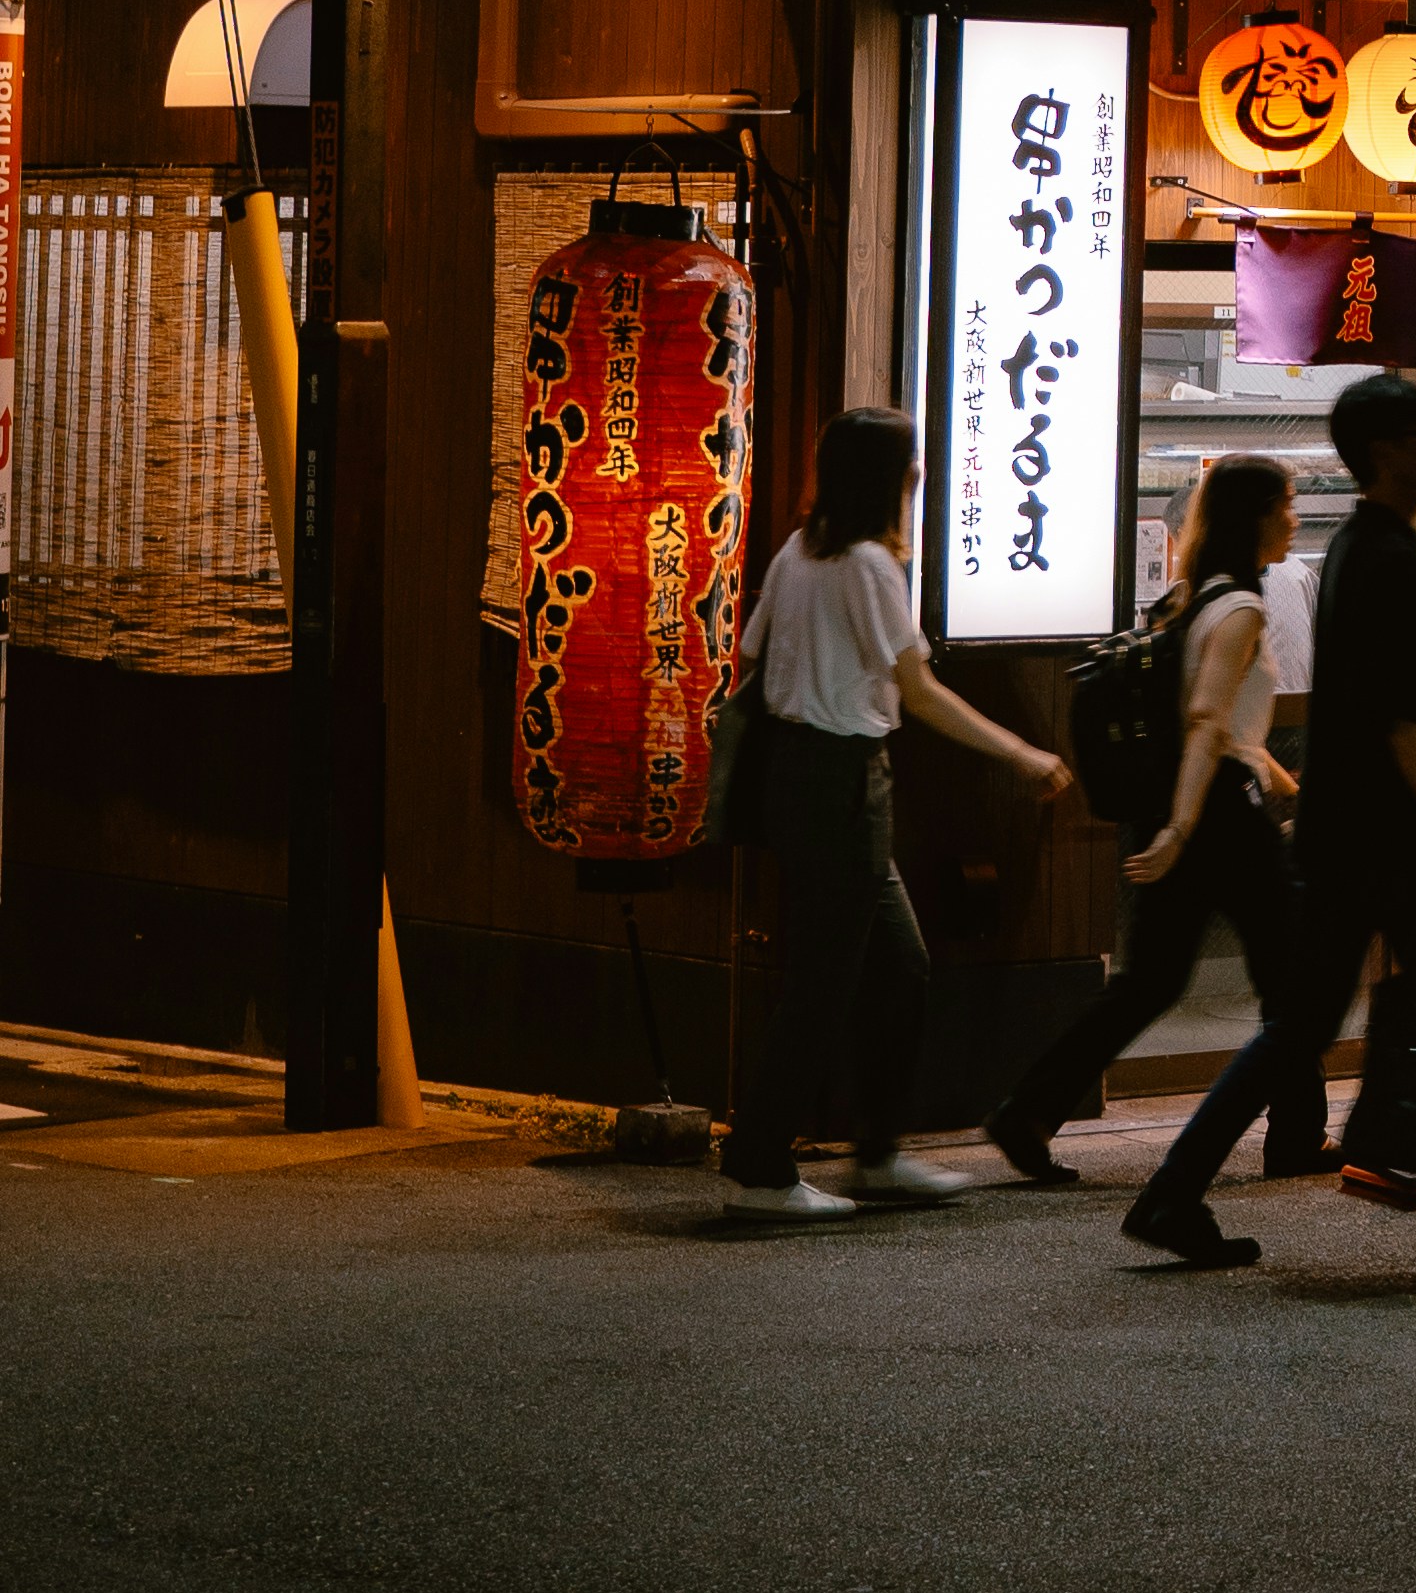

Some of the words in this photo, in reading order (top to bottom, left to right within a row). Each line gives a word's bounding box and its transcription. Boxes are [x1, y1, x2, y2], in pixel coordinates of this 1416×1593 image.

[1089, 93, 1114, 260] 創業昭和四年
[602, 271, 640, 479] 創業昭和四年
[1000, 88, 1078, 572] 串かつだるま
[1336, 255, 1377, 344] 元祖
[524, 269, 596, 847] 串かつだるま
[961, 299, 987, 577] 大阪新世界元祖串かつ
